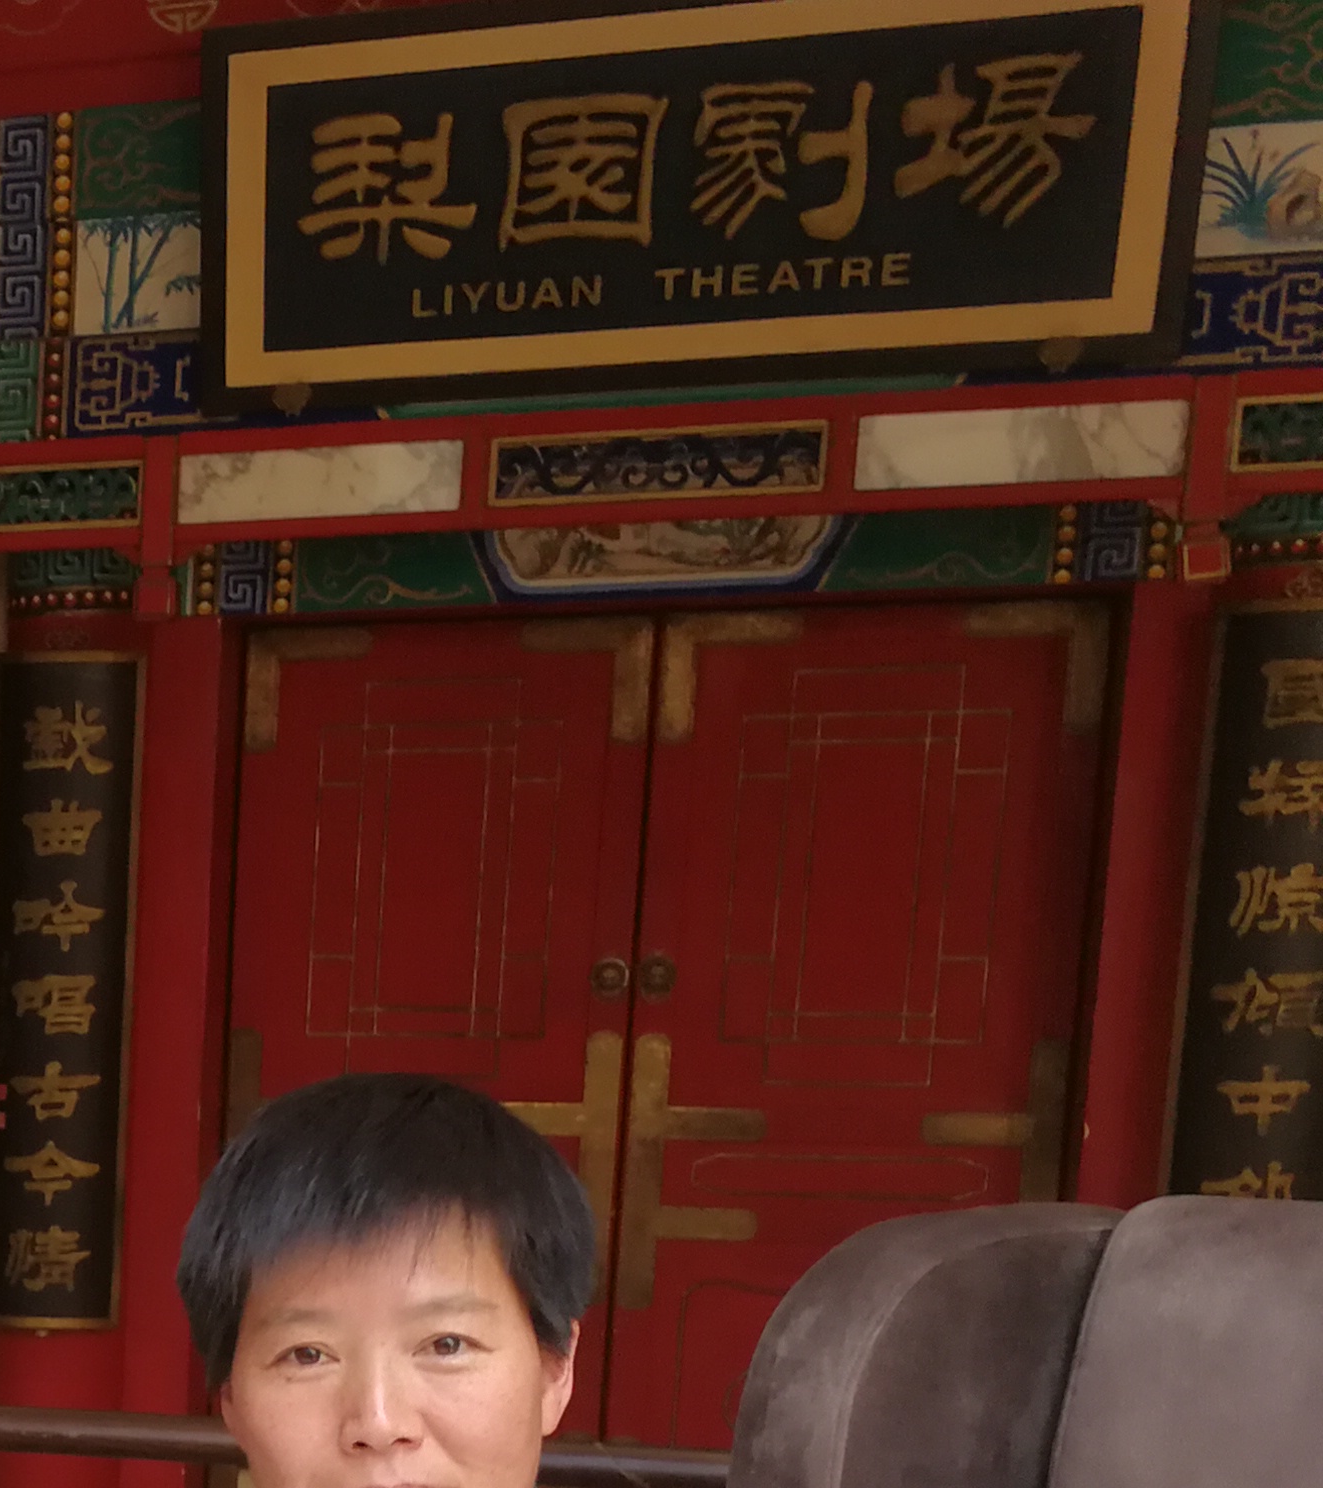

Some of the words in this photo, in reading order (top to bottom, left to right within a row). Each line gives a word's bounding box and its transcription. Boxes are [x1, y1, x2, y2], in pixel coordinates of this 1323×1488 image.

[298, 52, 1097, 266] 梨園劇場
[412, 273, 605, 320] LIYUAN
[654, 250, 915, 303] THEATRE
